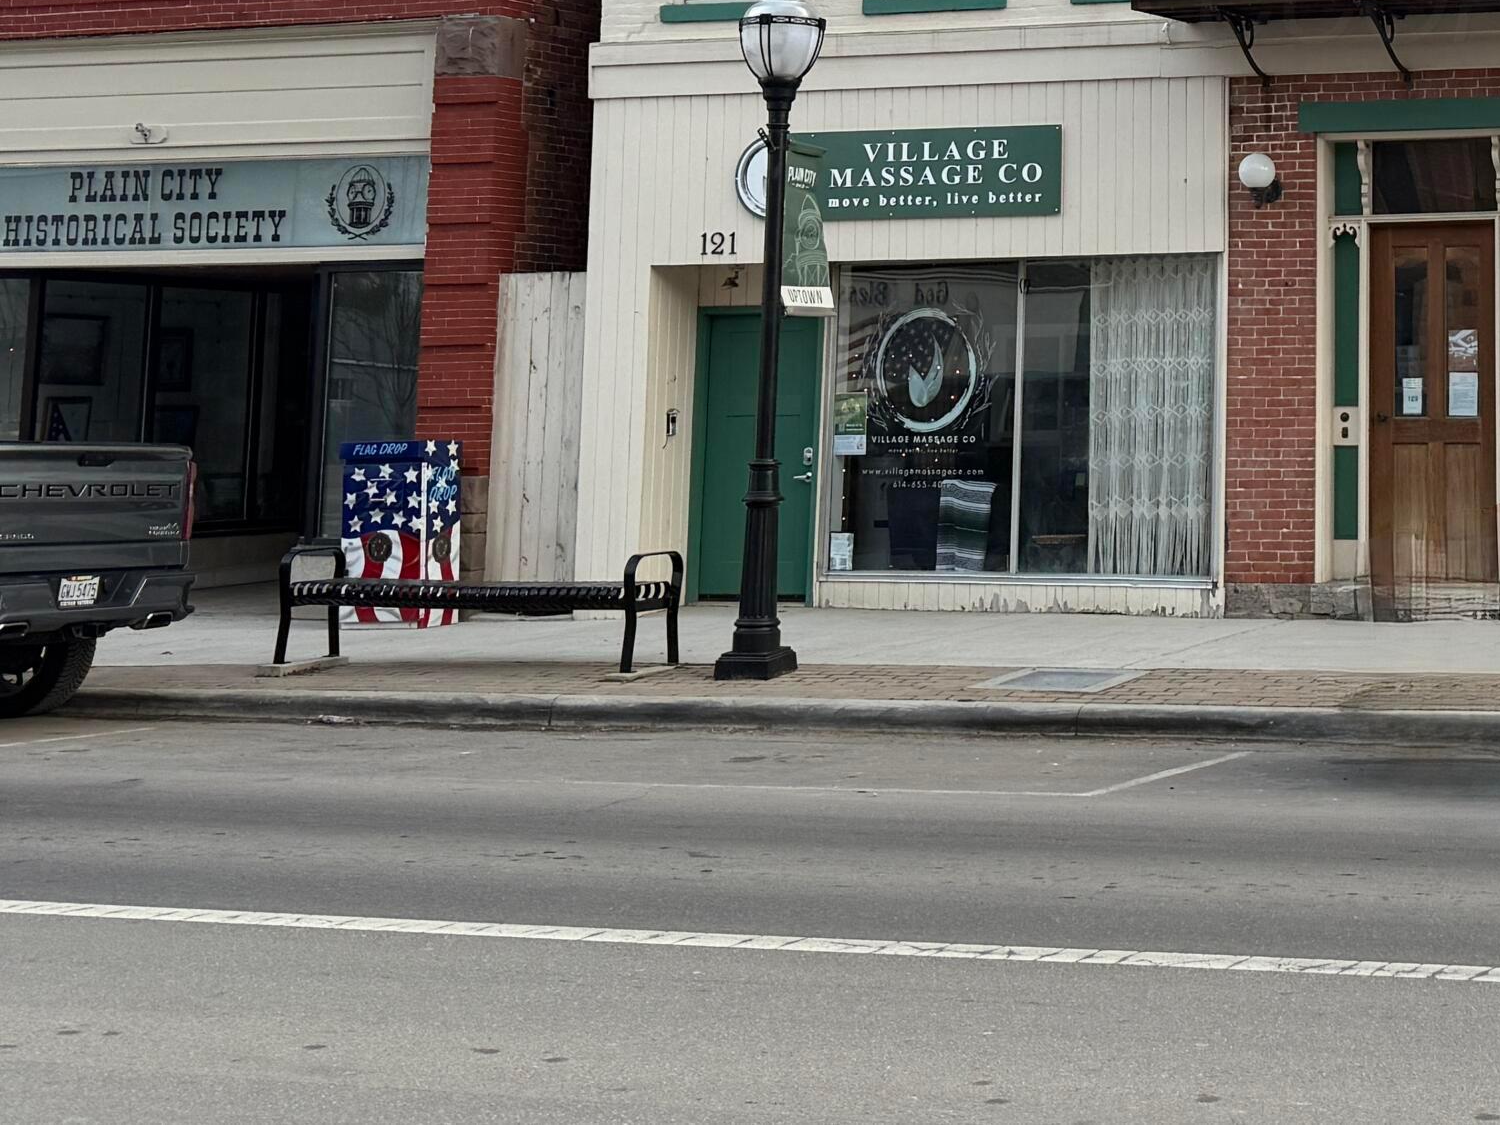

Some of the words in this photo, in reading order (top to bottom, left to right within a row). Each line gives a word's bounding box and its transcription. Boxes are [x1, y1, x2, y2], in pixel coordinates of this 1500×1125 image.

[863, 139, 1009, 163] VILLAGE
[787, 166, 804, 183] PLAIN
[828, 164, 984, 188] MASSAGE
[998, 162, 1043, 184] CO
[68, 170, 150, 203] PLAIN
[160, 167, 223, 202] CITY
[828, 197, 870, 208] move
[879, 195, 938, 208] better,
[946, 192, 979, 205] live
[988, 191, 1042, 204] better
[3, 212, 162, 247] HISTORICAL
[173, 209, 287, 244] SOCIETY
[700, 231, 737, 255] 121
[787, 288, 823, 305] UPTOWN
[871, 435, 910, 444] VILLAGE
[912, 435, 959, 444] MASSAGE
[962, 435, 976, 443] CO
[353, 444, 378, 456] FLAG
[379, 442, 408, 455] DROP
[0, 483, 180, 499] CHEVROLET
